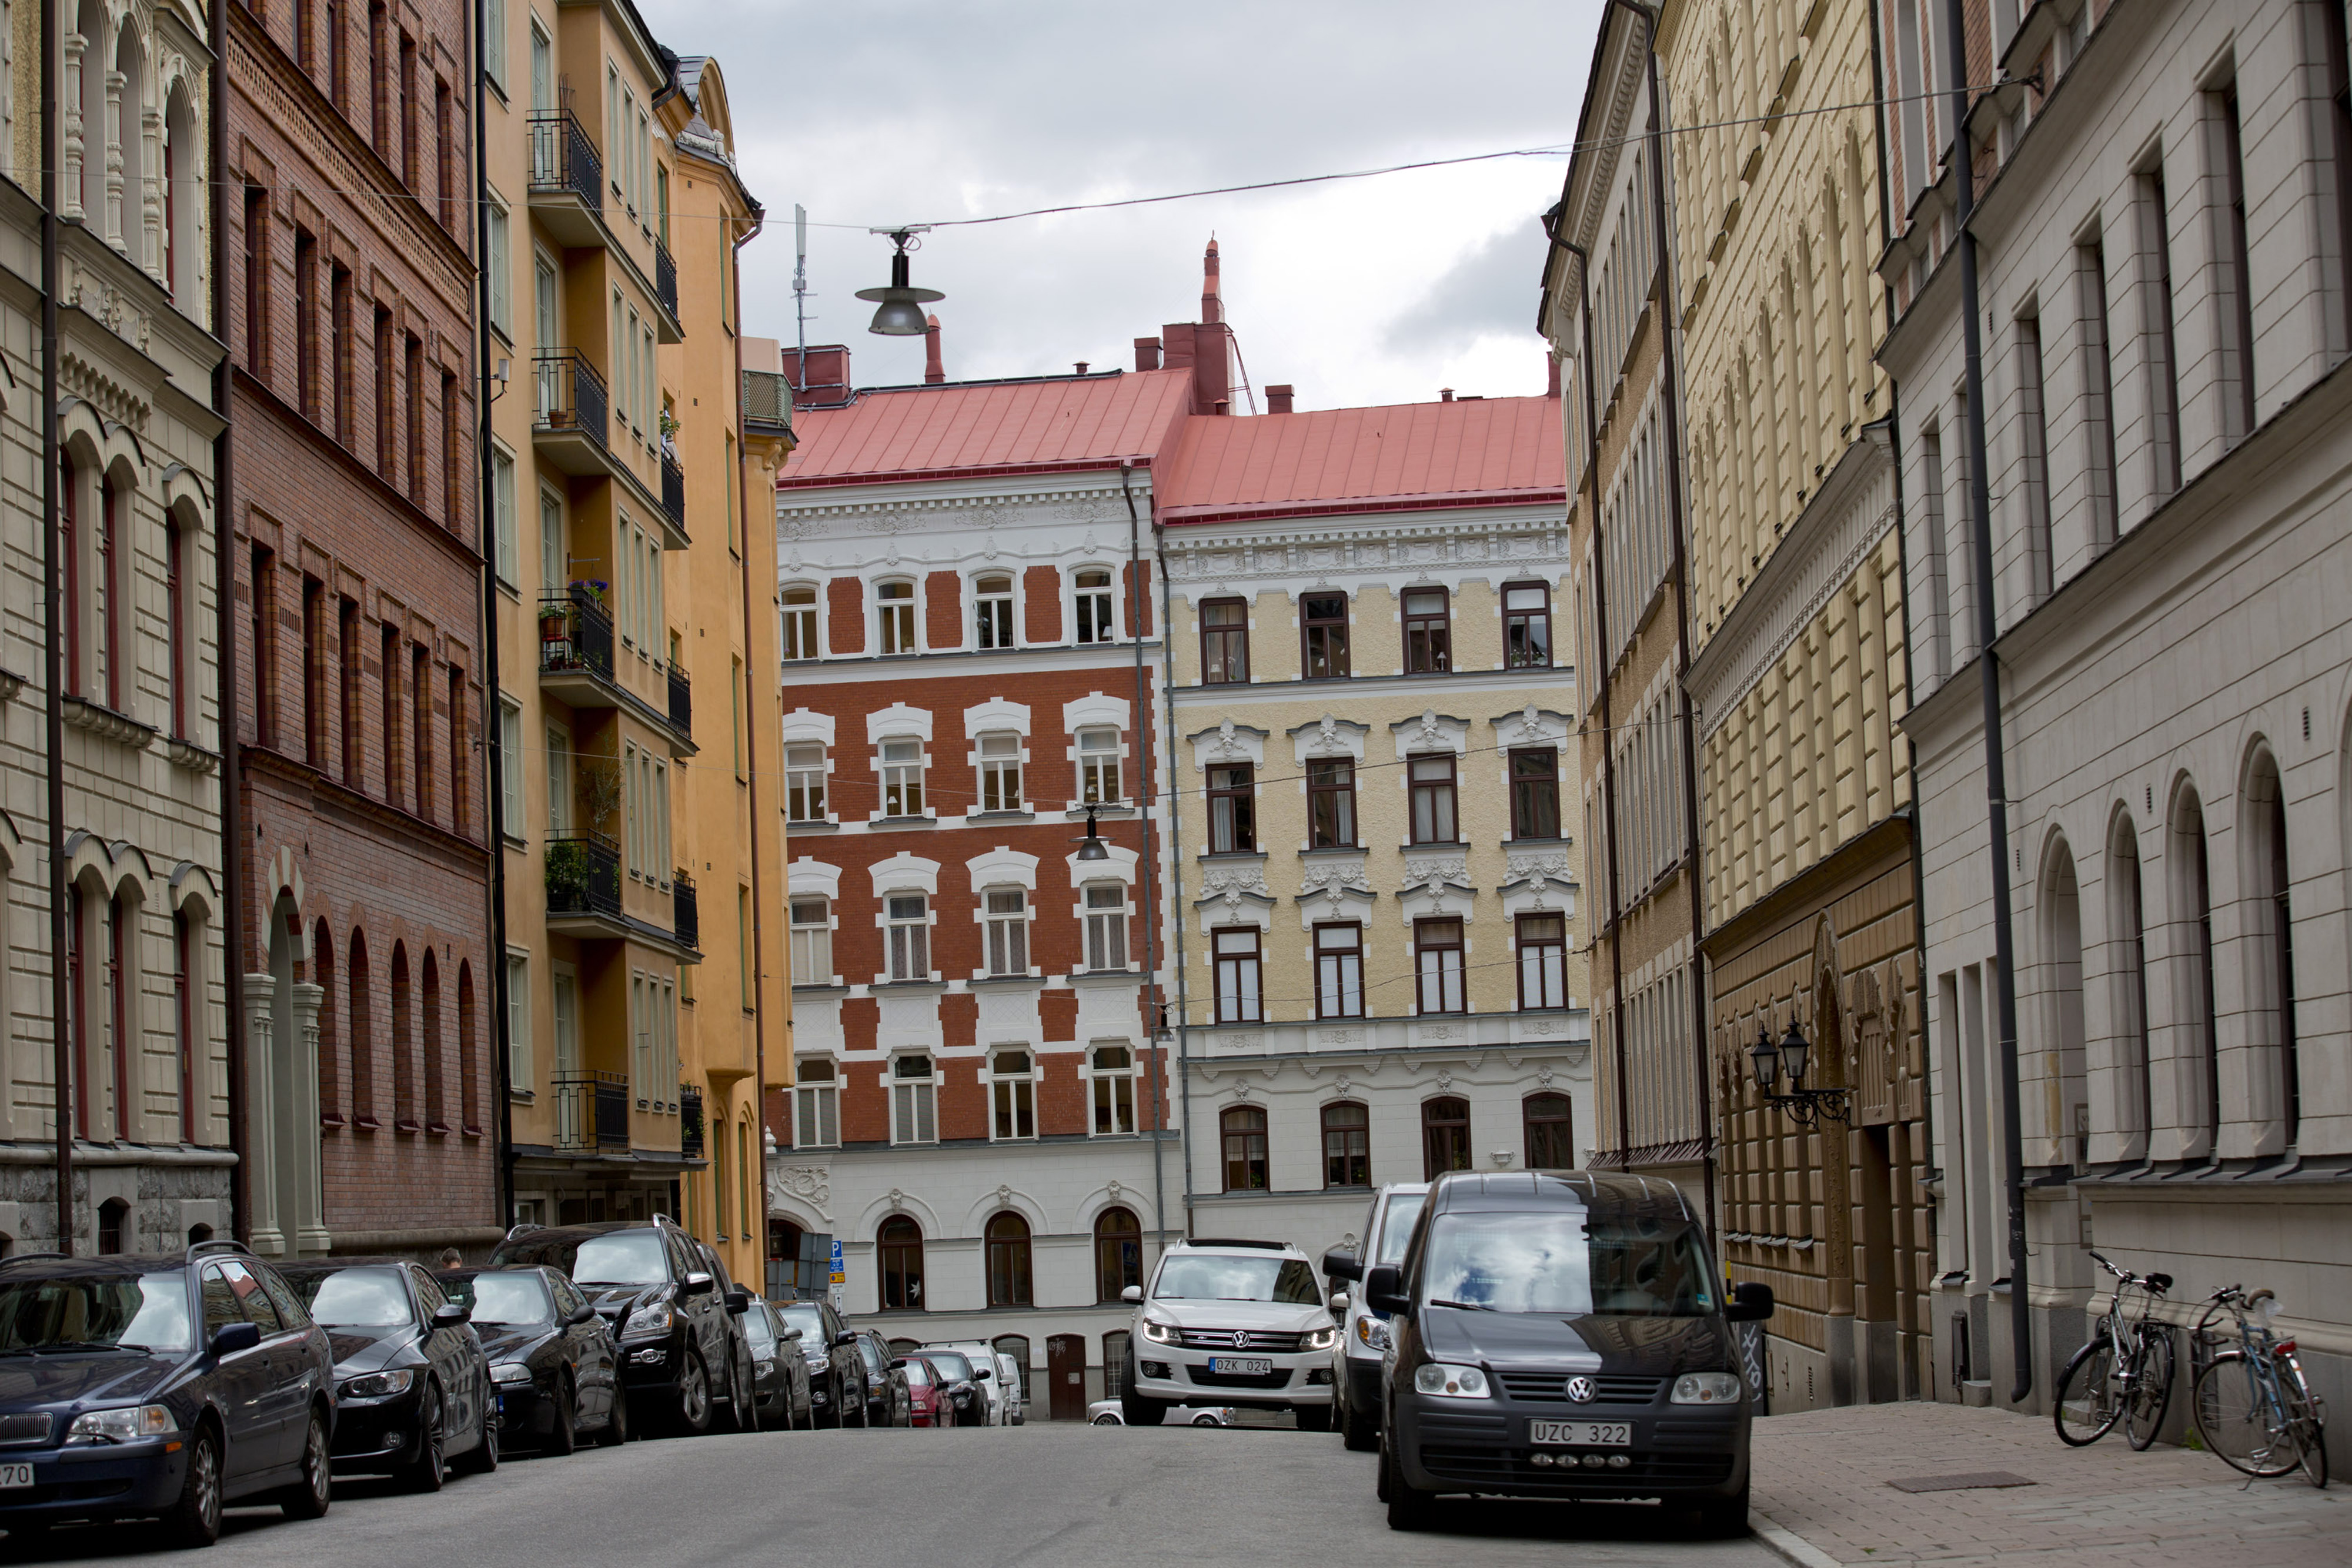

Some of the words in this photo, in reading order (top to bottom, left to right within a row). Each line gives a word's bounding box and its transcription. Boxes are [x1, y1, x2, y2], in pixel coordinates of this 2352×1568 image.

[832, 1242, 839, 1256] P
[1217, 1360, 1238, 1370] OZK
[1247, 1361, 1268, 1371] 024
[1535, 1424, 1573, 1442] UZC
[1589, 1425, 1626, 1443] 322
[0, 1466, 29, 1485] 70
